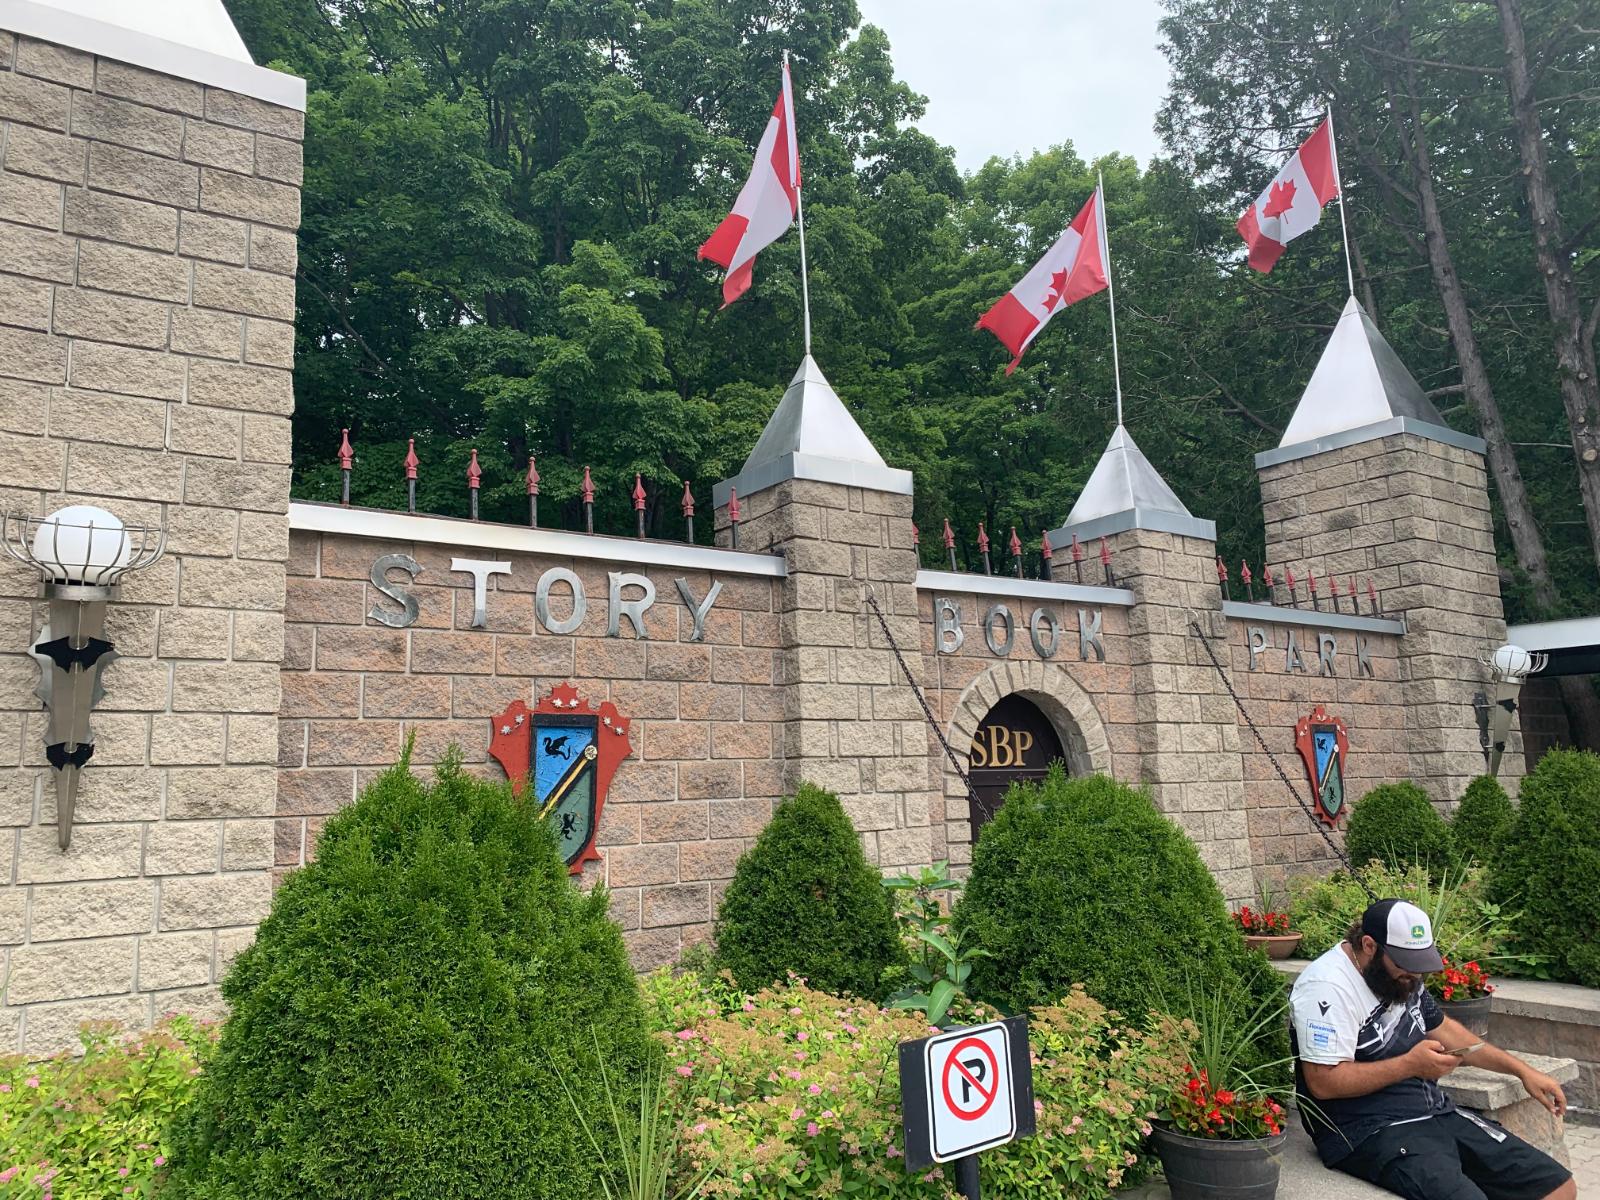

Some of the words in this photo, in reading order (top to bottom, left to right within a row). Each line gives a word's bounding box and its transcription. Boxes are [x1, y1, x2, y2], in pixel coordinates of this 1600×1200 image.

[367, 553, 724, 641] STORY
[935, 597, 1105, 661] BOOK
[1247, 626, 1376, 678] PARK
[971, 725, 1034, 767] SBP
[961, 1058, 986, 1104] P
